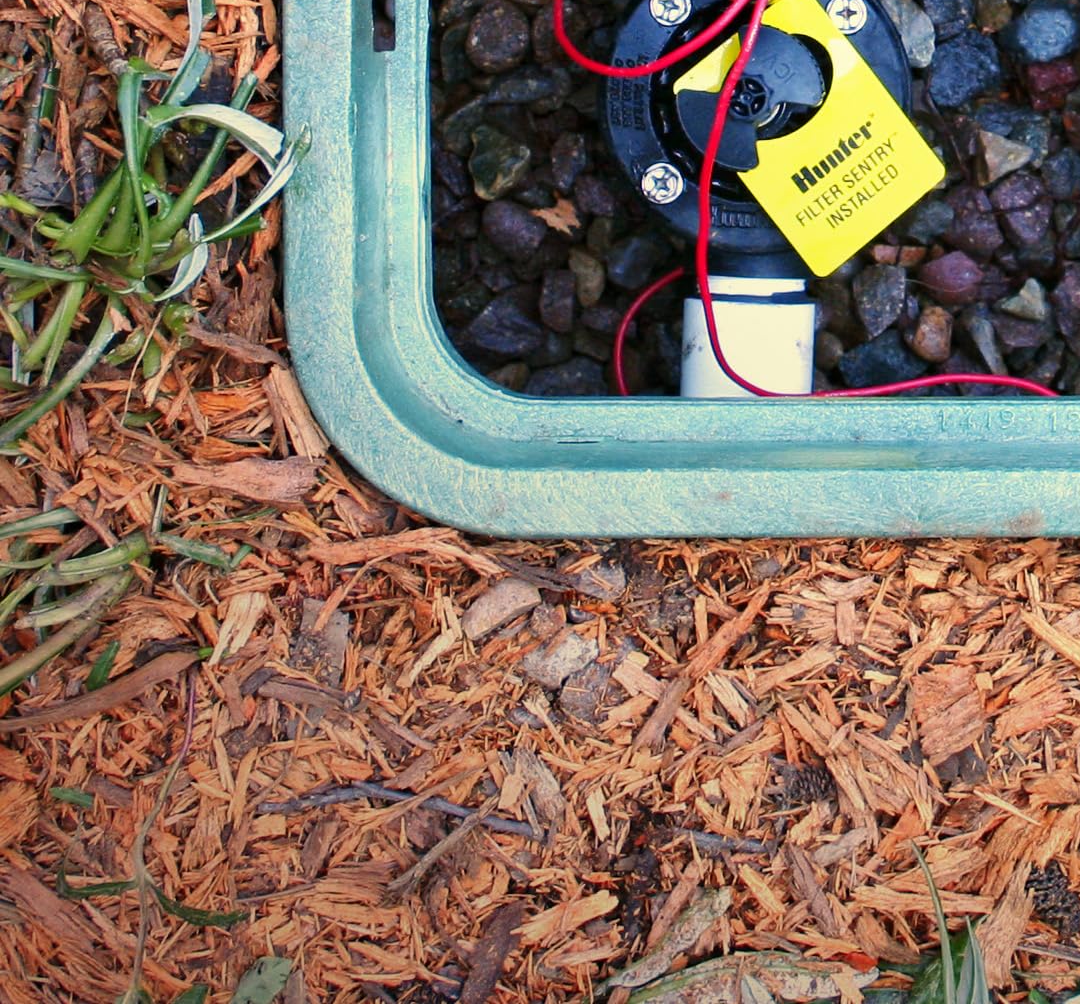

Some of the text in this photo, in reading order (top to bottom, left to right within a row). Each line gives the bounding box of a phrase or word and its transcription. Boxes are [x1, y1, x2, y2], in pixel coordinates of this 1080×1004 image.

[790, 120, 872, 194] Hunter
[795, 184, 844, 227] FILTER
[841, 137, 895, 189] SENTRY
[825, 164, 899, 229] INSTALLED
